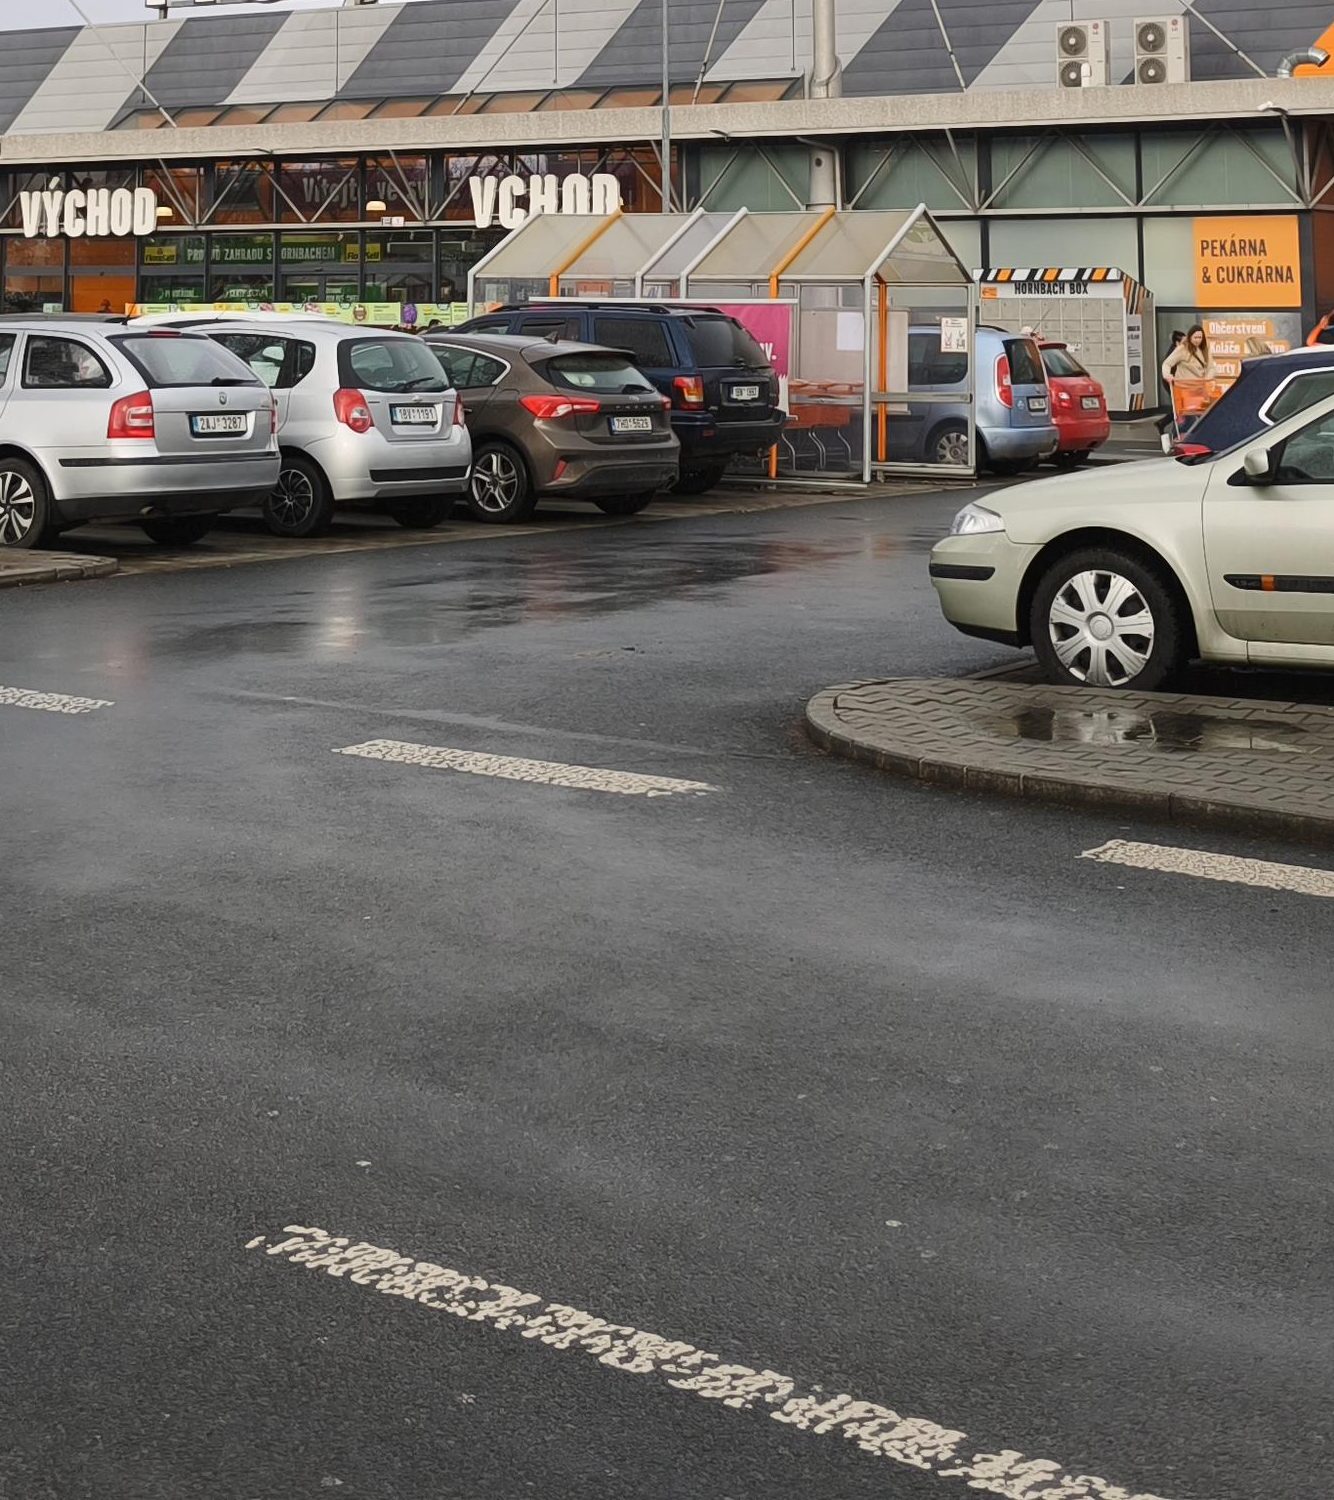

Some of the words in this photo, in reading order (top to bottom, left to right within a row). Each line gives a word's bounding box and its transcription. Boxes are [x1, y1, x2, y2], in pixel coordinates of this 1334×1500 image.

[302, 175, 359, 208] Vítejt
[469, 173, 621, 229] VCHOD
[19, 176, 157, 238] VÝCHOD
[224, 248, 264, 261] ZAHRADU
[280, 247, 336, 260] ORNBACHEM
[1200, 233, 1268, 258] PEKÁRNA
[1201, 266, 1212, 284] &
[1216, 260, 1294, 284] CUKRÁRNA
[1014, 281, 1065, 295] HORNBACH
[1069, 282, 1089, 295] BOX
[1208, 321, 1267, 335] Občerstvení
